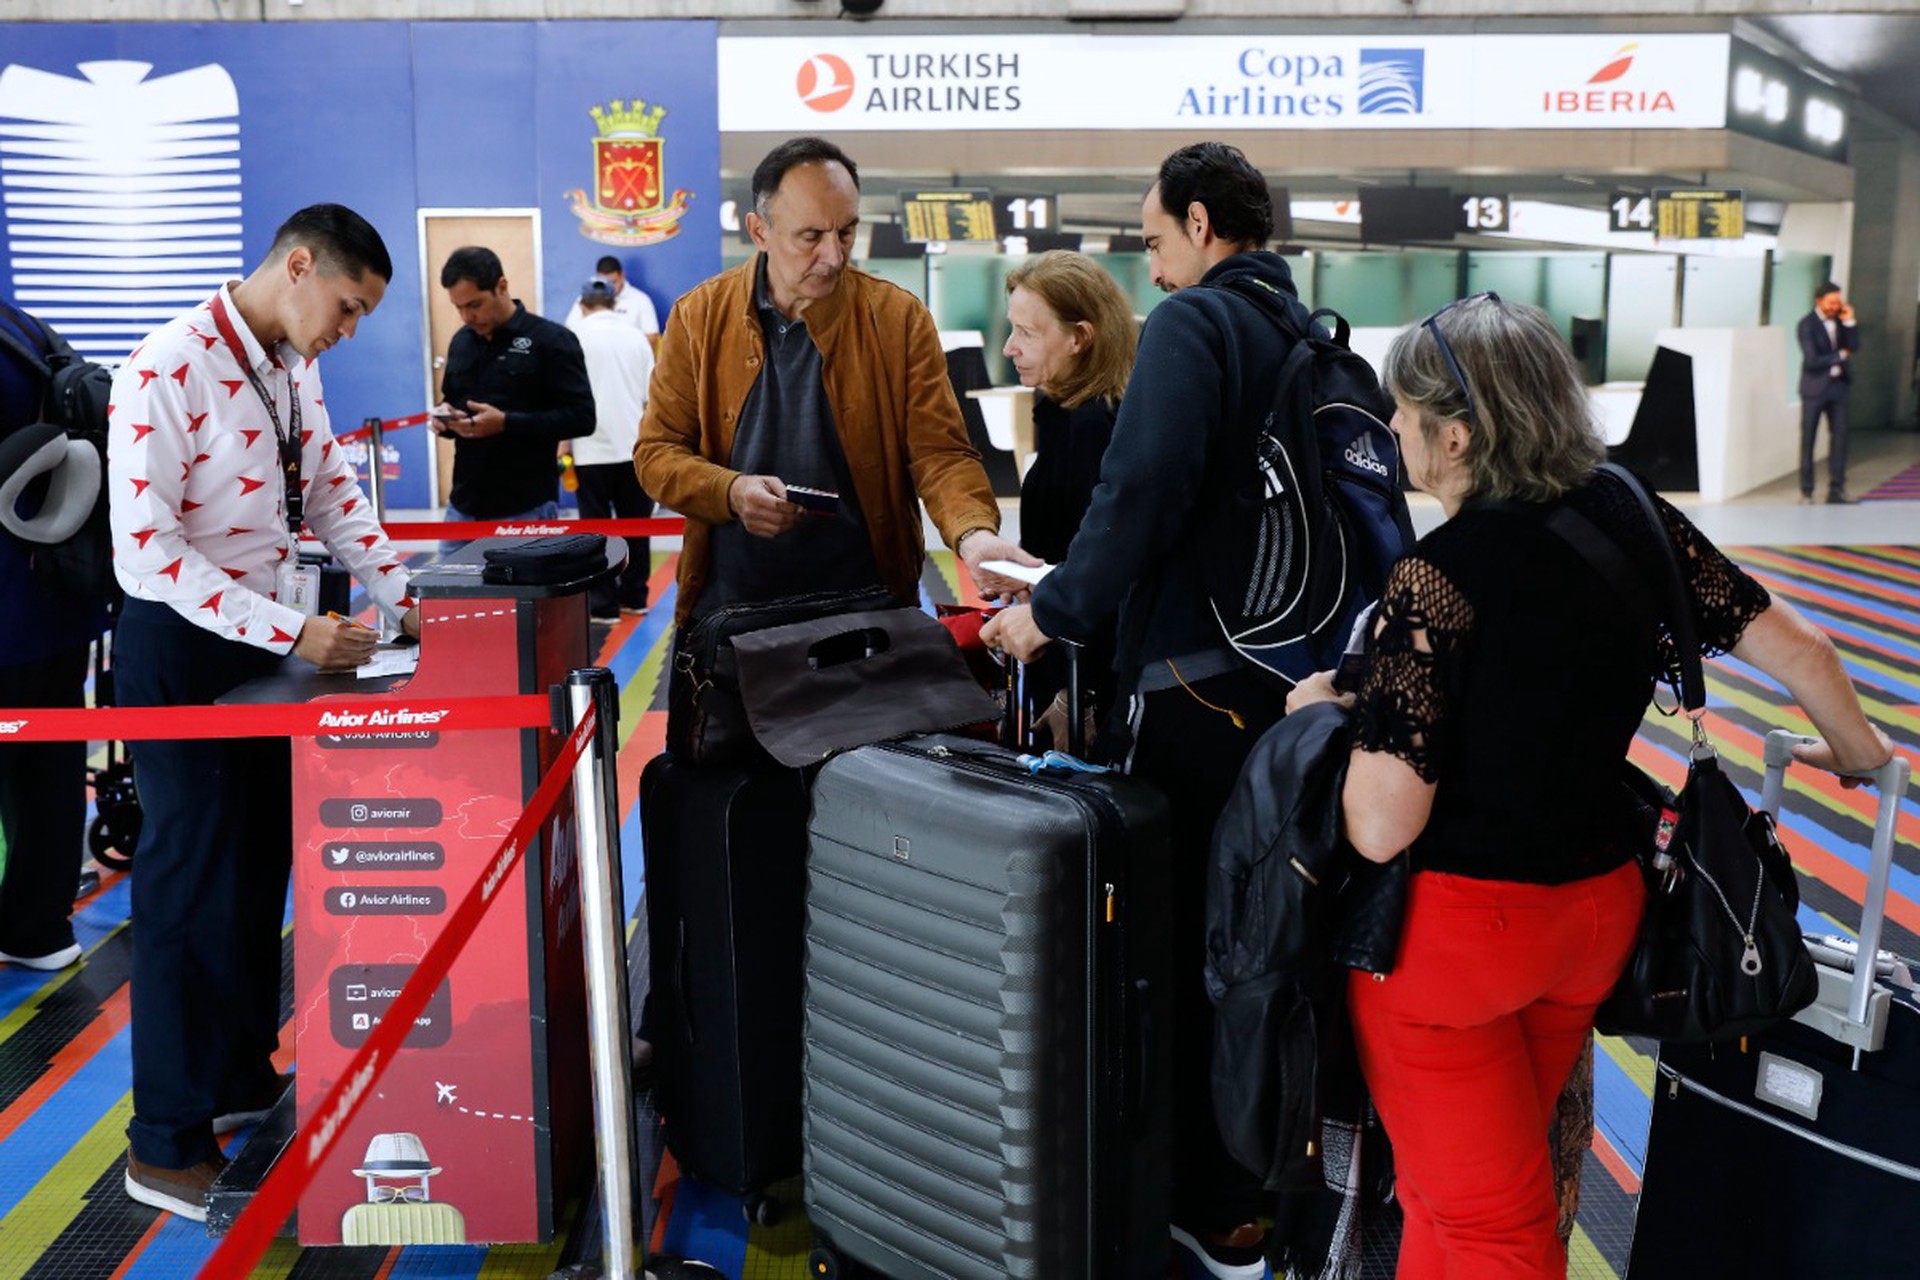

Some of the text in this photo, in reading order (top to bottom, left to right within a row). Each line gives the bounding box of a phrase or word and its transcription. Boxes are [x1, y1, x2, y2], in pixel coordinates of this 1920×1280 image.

[866, 53, 1019, 79] TURKISH
[1238, 48, 1343, 86] Copa
[865, 86, 1021, 112] AIRLINES
[1177, 86, 1343, 116] Airlines
[1543, 91, 1675, 113] IBERIA
[1007, 198, 1047, 229] 11
[1463, 197, 1503, 228] 13
[1612, 197, 1653, 228] 14
[1344, 448, 1388, 477] adidas
[318, 708, 440, 727] Avior Airlines
[371, 808, 411, 819] aviorair
[355, 850, 436, 863] @aviorairlines
[360, 894, 431, 905] Avior Airlines
